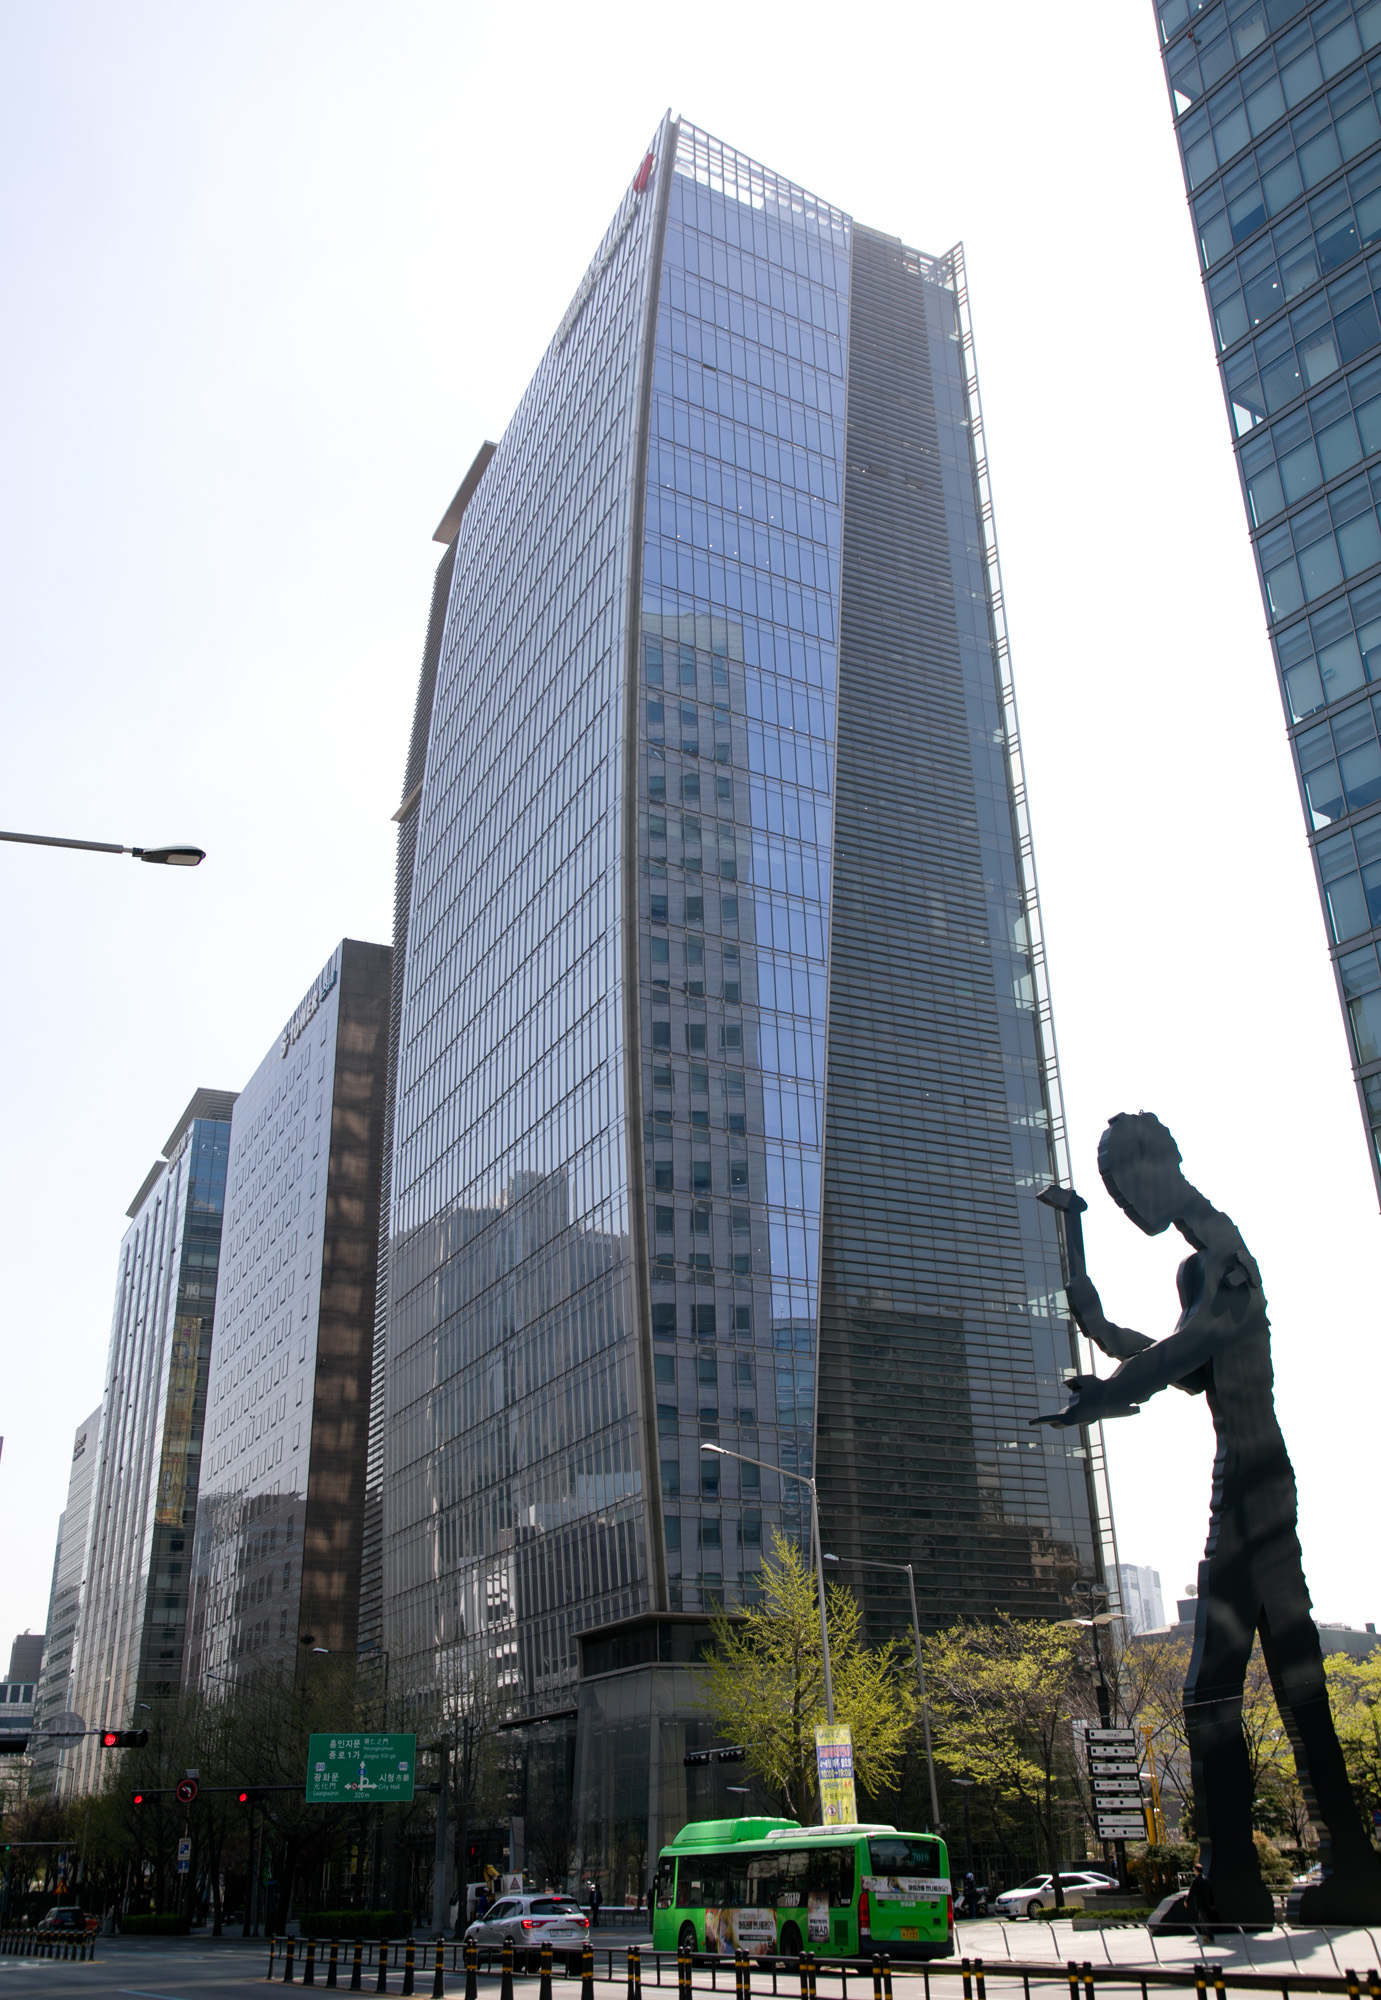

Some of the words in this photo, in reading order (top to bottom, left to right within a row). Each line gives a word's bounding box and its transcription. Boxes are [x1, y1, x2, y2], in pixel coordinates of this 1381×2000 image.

[329, 1739, 361, 1749] 흥인지문
[313, 1772, 339, 1782] 광화문
[379, 1773, 395, 1783] 시청
[911, 1853, 930, 1863] 7019
[785, 1892, 800, 1906] 7019
